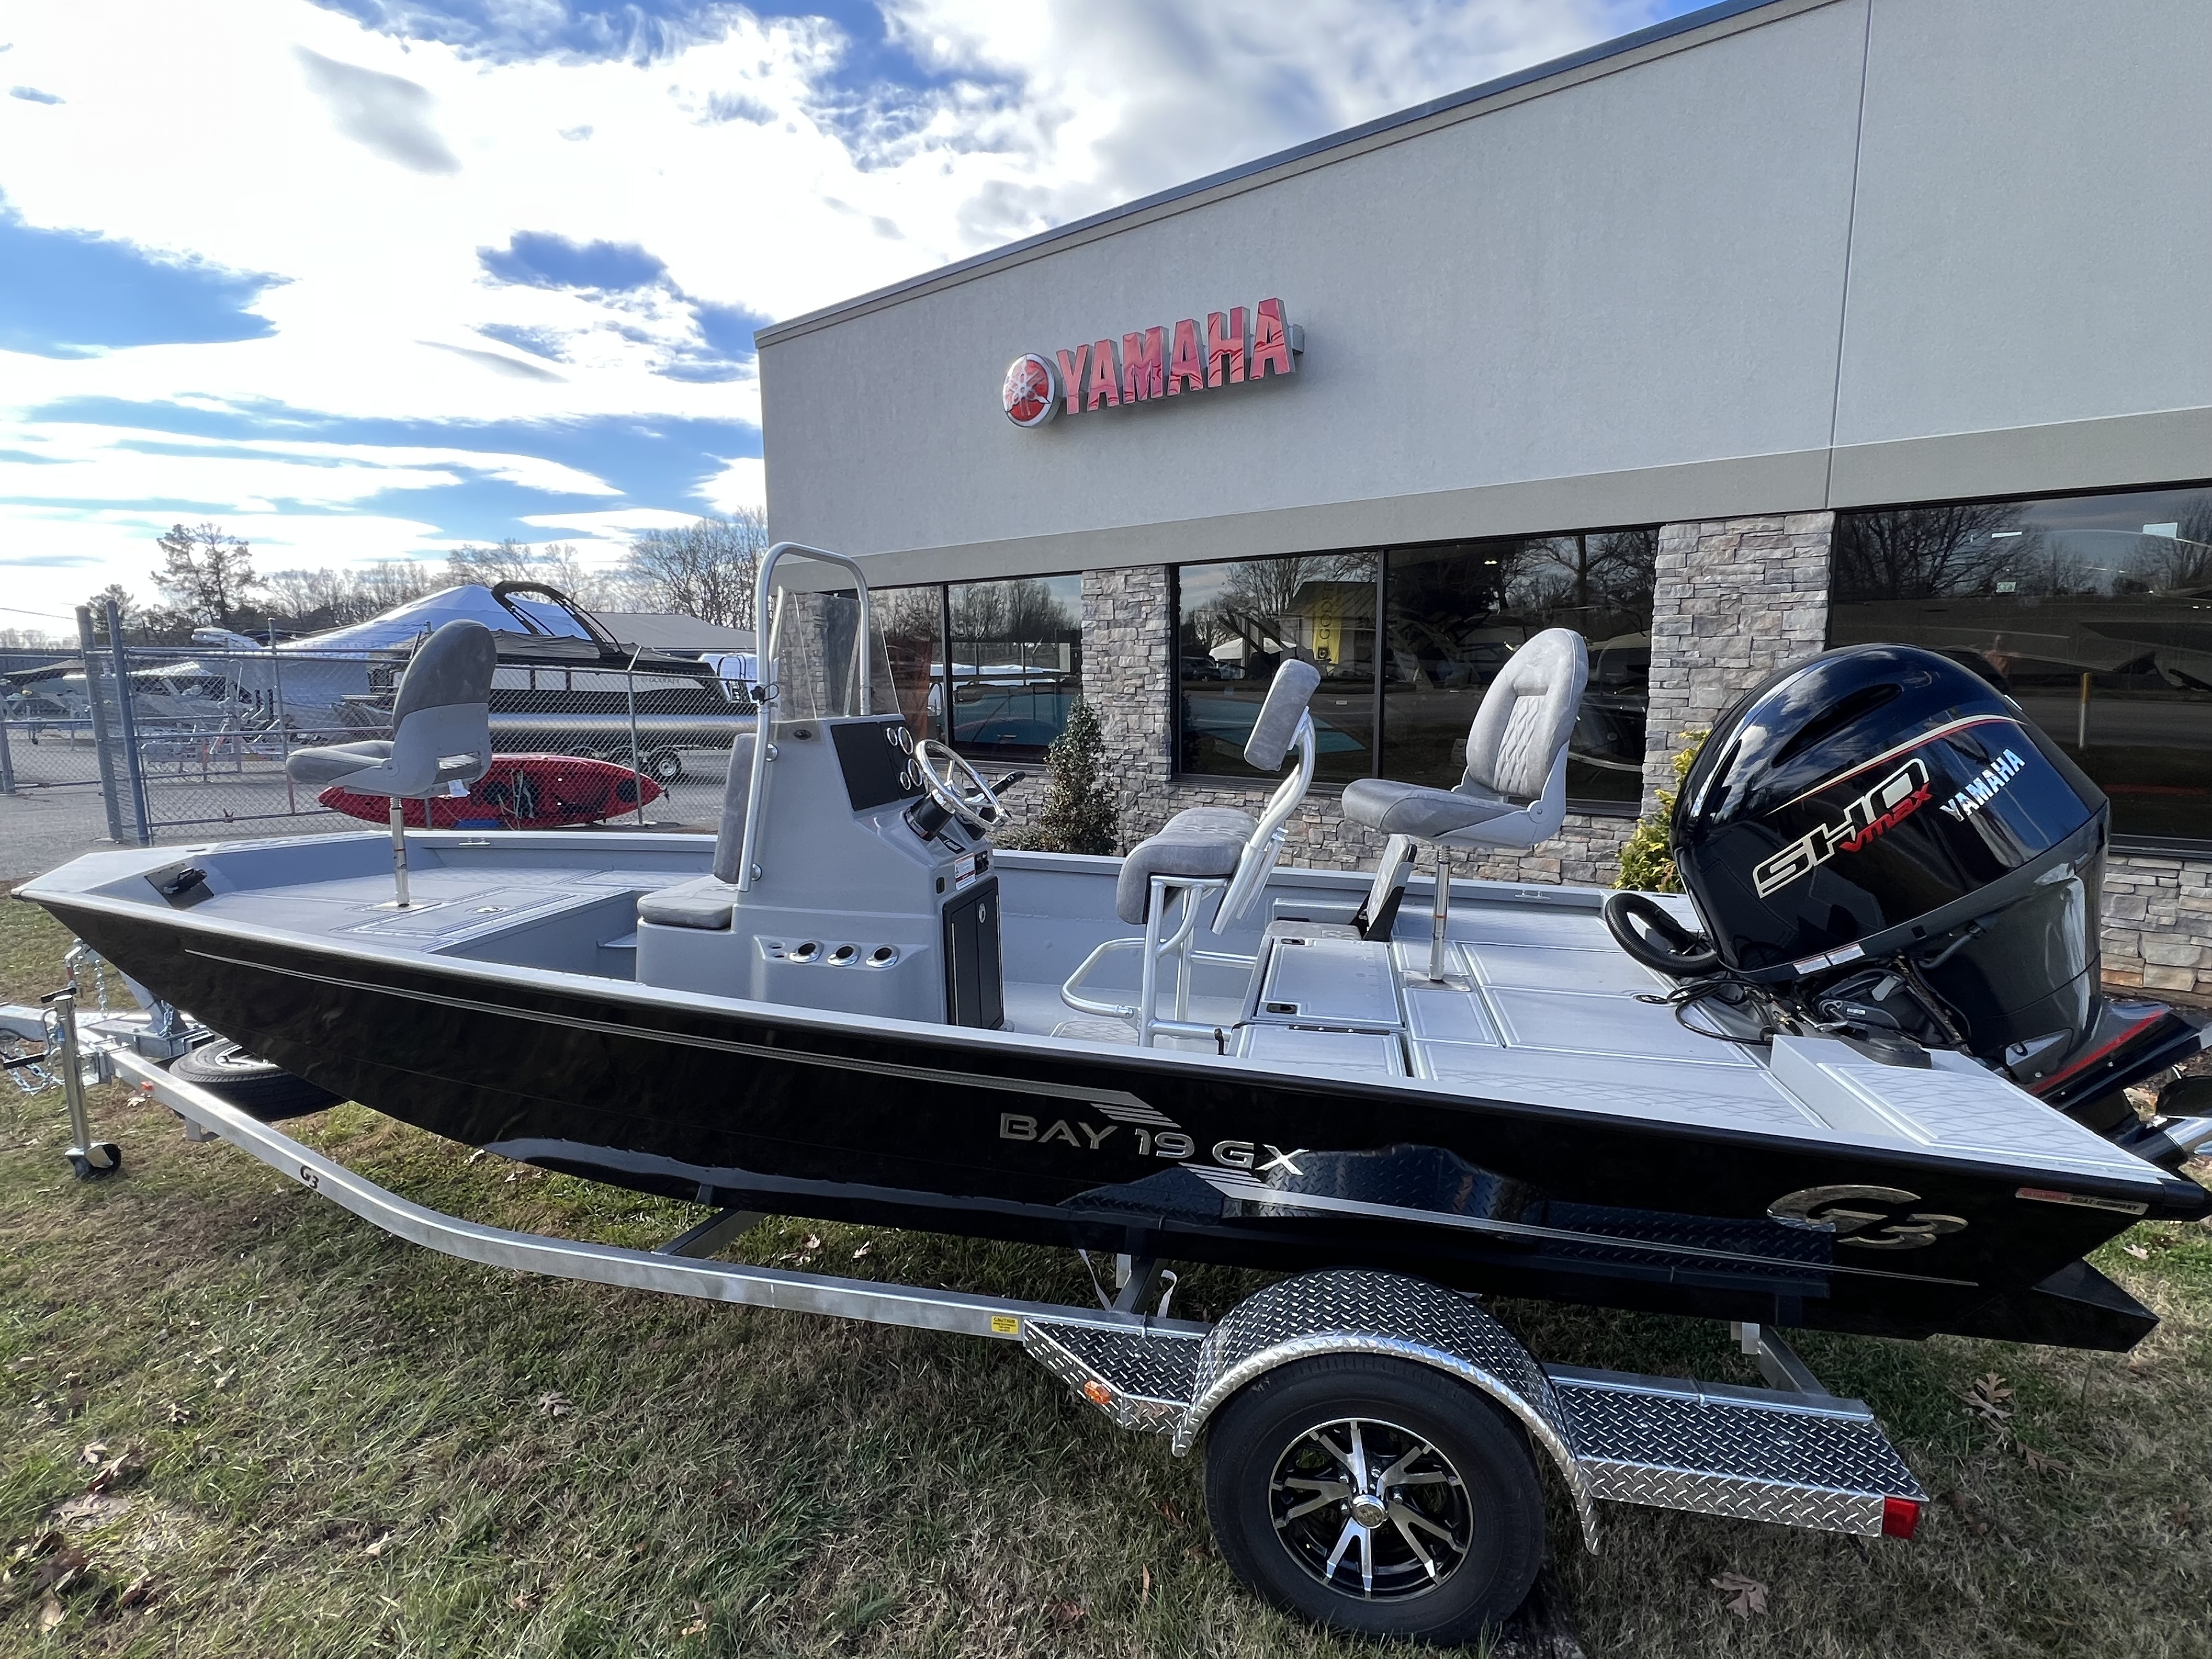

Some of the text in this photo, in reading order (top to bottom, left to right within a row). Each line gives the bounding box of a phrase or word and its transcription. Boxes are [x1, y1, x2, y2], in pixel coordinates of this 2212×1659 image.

[1056, 297, 1290, 415] YAMAHA
[1939, 748, 2025, 822] YAMAHA
[1752, 758, 1929, 899] SHO
[300, 1165, 319, 1189] G3
[1000, 1113, 1310, 1176] BAY 19 GX
[1767, 1184, 1968, 1249] G3
